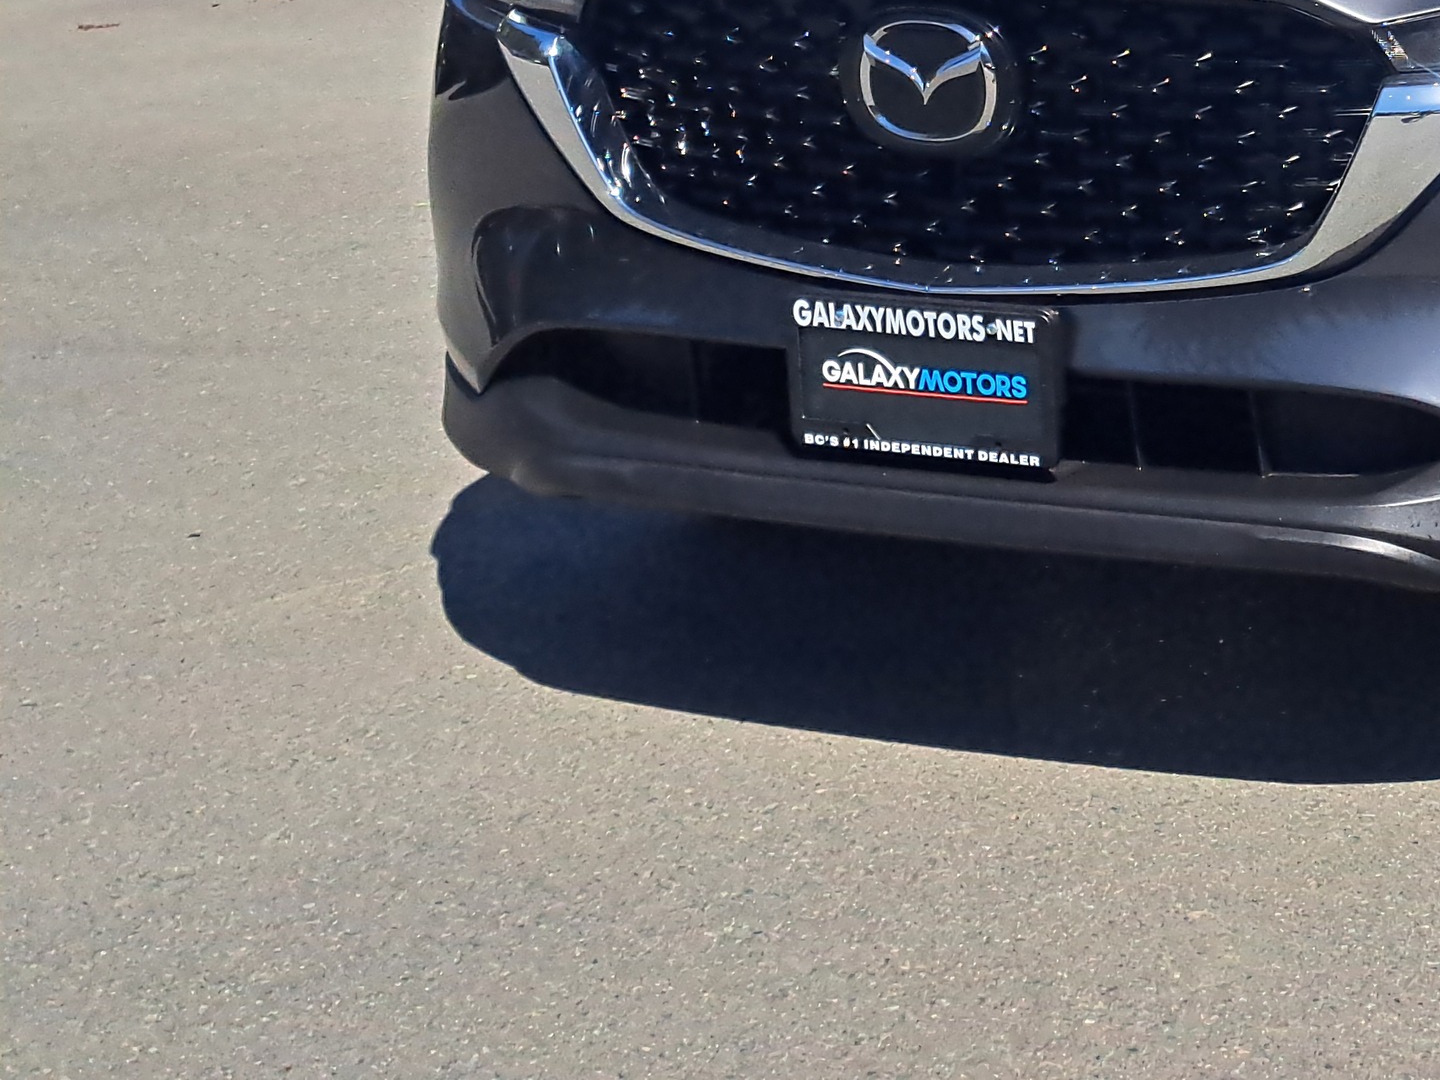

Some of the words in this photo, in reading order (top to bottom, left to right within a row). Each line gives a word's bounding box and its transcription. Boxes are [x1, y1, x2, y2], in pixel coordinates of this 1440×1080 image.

[821, 360, 1028, 399] GALAXYMOTORS
[804, 433, 839, 448] BC'S
[863, 438, 975, 461] INDEPENDENT
[977, 450, 1041, 468] DEALER
